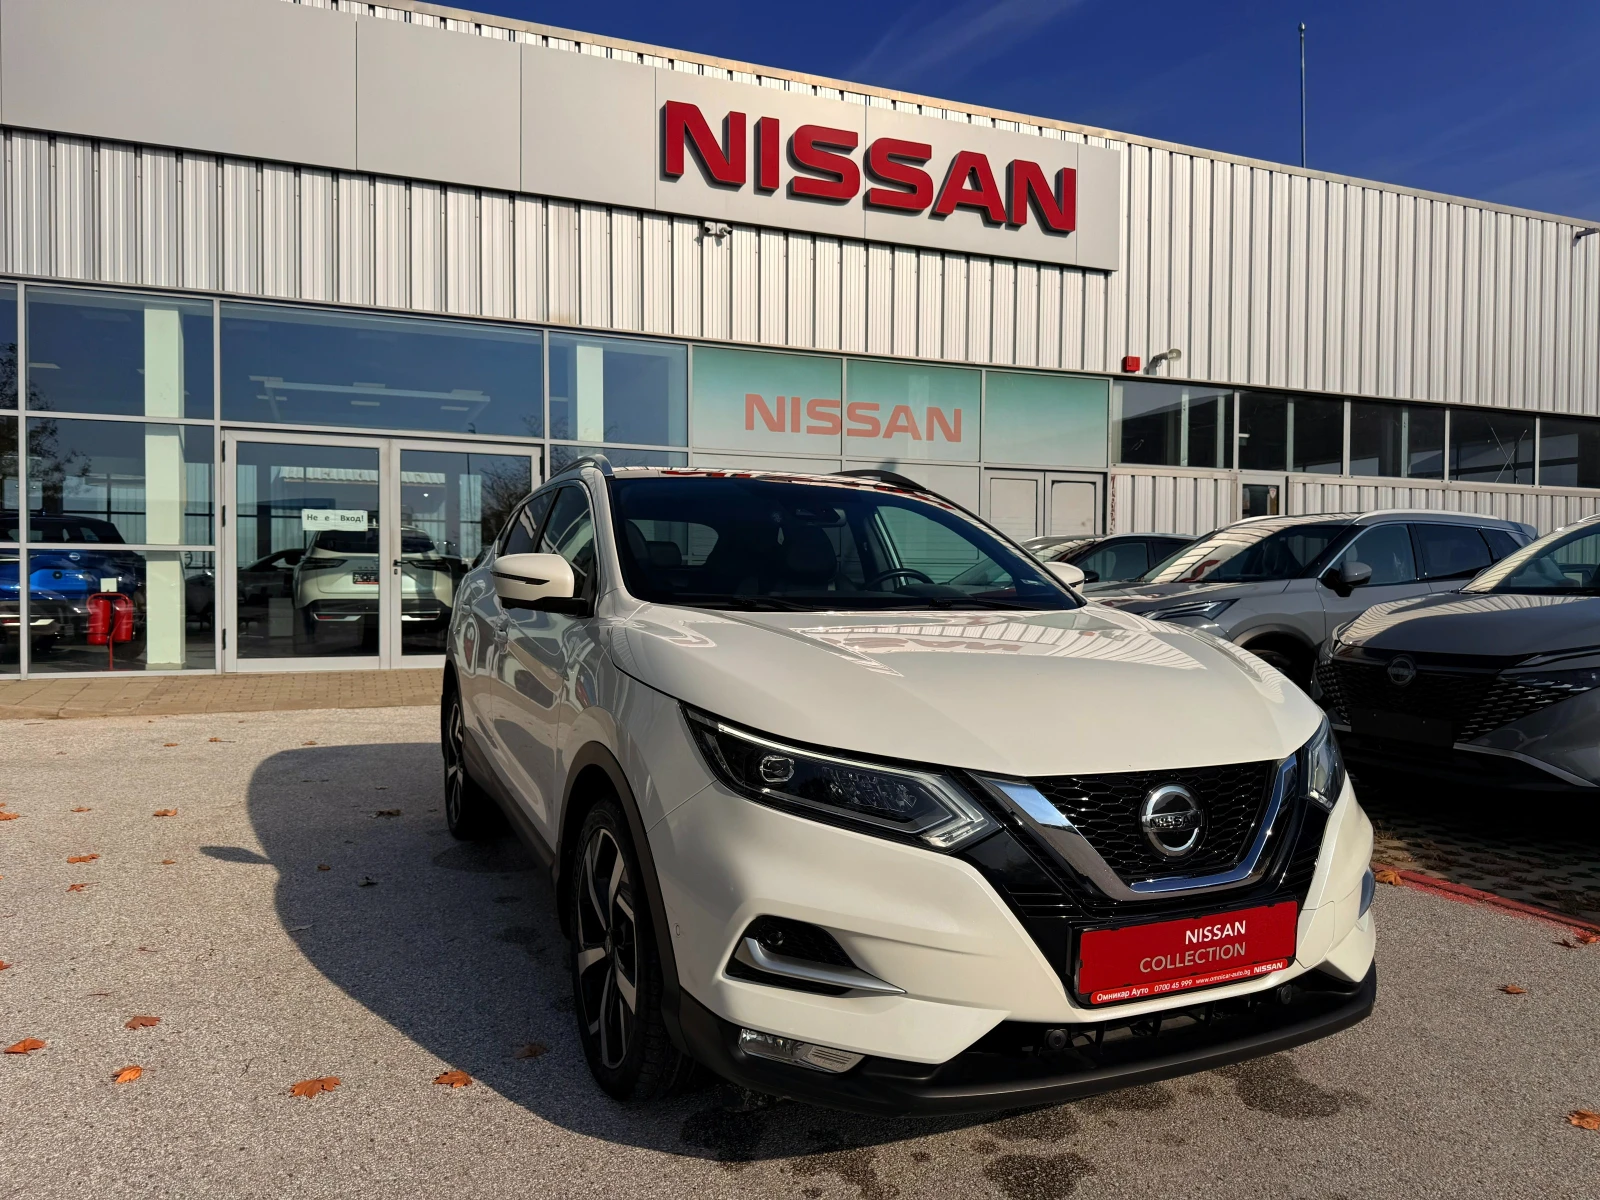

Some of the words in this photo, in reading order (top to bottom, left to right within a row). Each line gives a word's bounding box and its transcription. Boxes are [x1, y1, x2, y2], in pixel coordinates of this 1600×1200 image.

[662, 99, 1077, 234] NISSAN
[744, 393, 963, 444] NISSAN
[306, 513, 318, 521] Не
[340, 514, 364, 523] Вход!
[1185, 920, 1246, 944] NISSAN
[1139, 942, 1246, 973] COLLECTION
[1096, 990, 1130, 1002] Омникар
[1131, 987, 1149, 997] Ауто
[1154, 984, 1170, 993] 0700
[1180, 979, 1193, 987] 999
[1253, 962, 1283, 974] NISSAN
